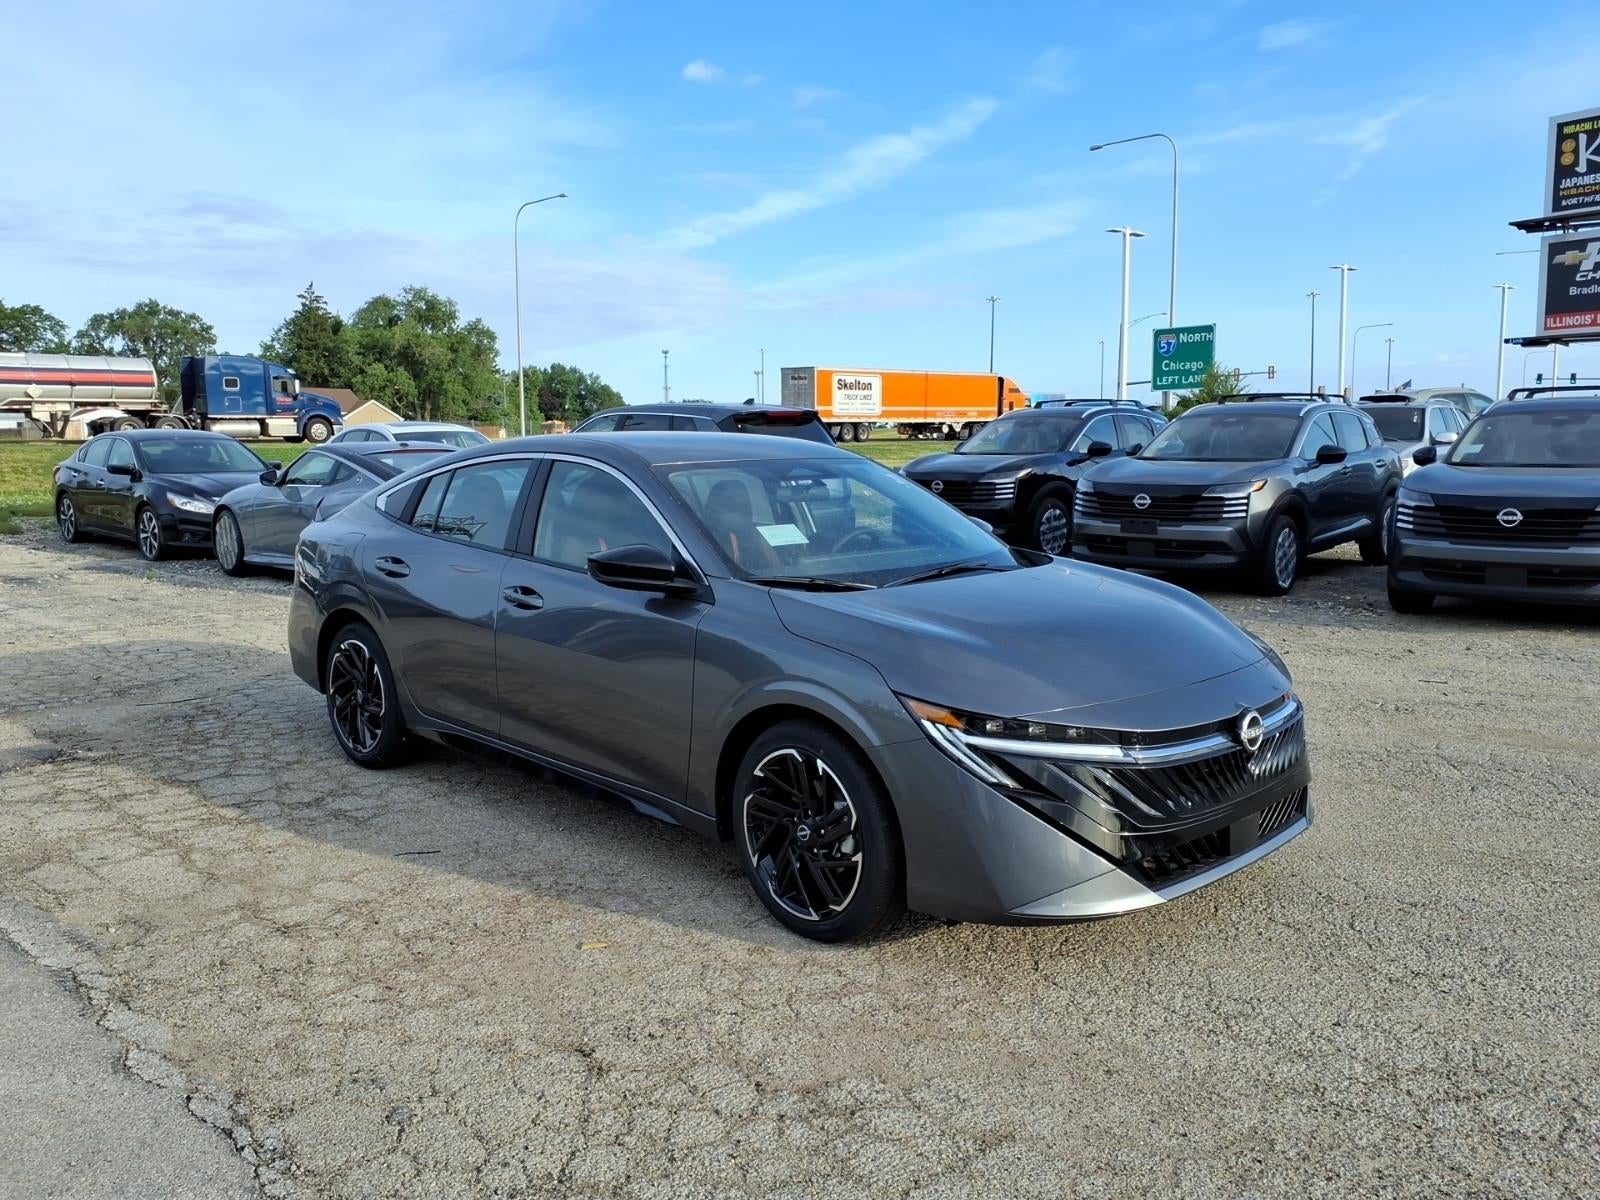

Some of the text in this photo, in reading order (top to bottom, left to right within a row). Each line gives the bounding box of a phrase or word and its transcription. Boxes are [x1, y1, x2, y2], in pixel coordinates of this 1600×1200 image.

[1563, 121, 1592, 134] HIBACHI
[1559, 173, 1600, 188] JAPANES
[1160, 339, 1176, 352] 57
[1179, 332, 1213, 343] NORTH
[1161, 360, 1204, 372] Chicago
[837, 378, 873, 391] Skelton
[1156, 375, 1179, 385] LEFT
